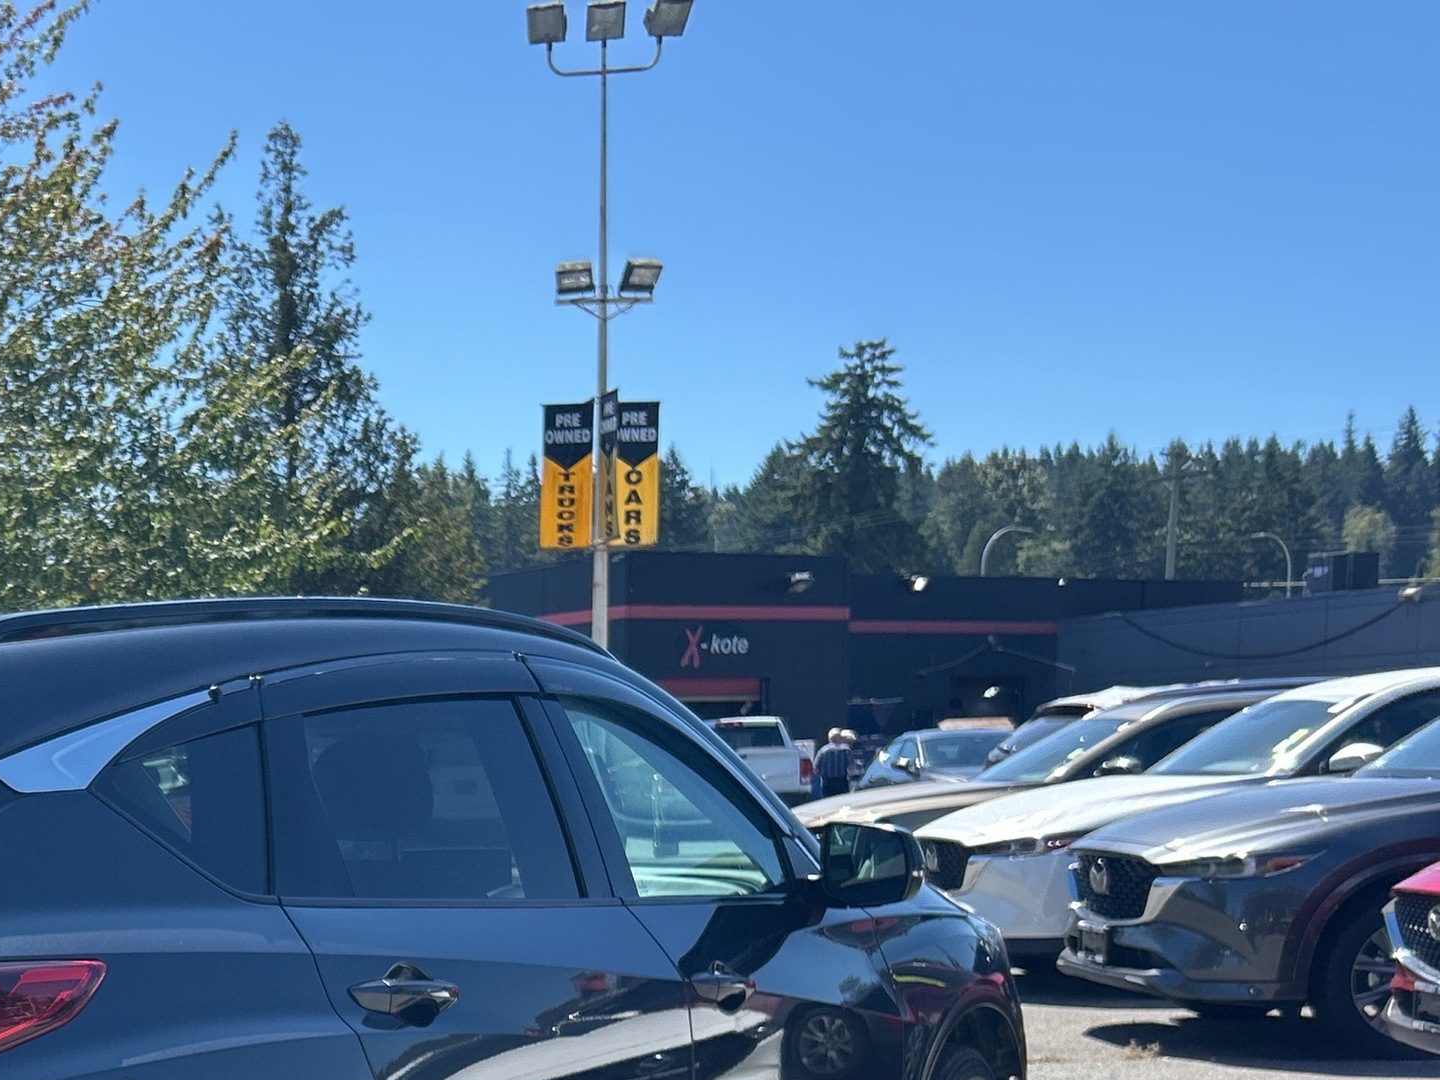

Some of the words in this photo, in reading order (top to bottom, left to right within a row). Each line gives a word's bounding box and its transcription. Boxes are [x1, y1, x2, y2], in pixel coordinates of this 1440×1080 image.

[555, 412, 582, 428] PRE
[622, 410, 648, 426] PRE
[545, 428, 592, 445] OWNED
[556, 471, 576, 547] TRUCKS
[624, 470, 643, 545] CARS
[680, 624, 749, 669] X-kote
